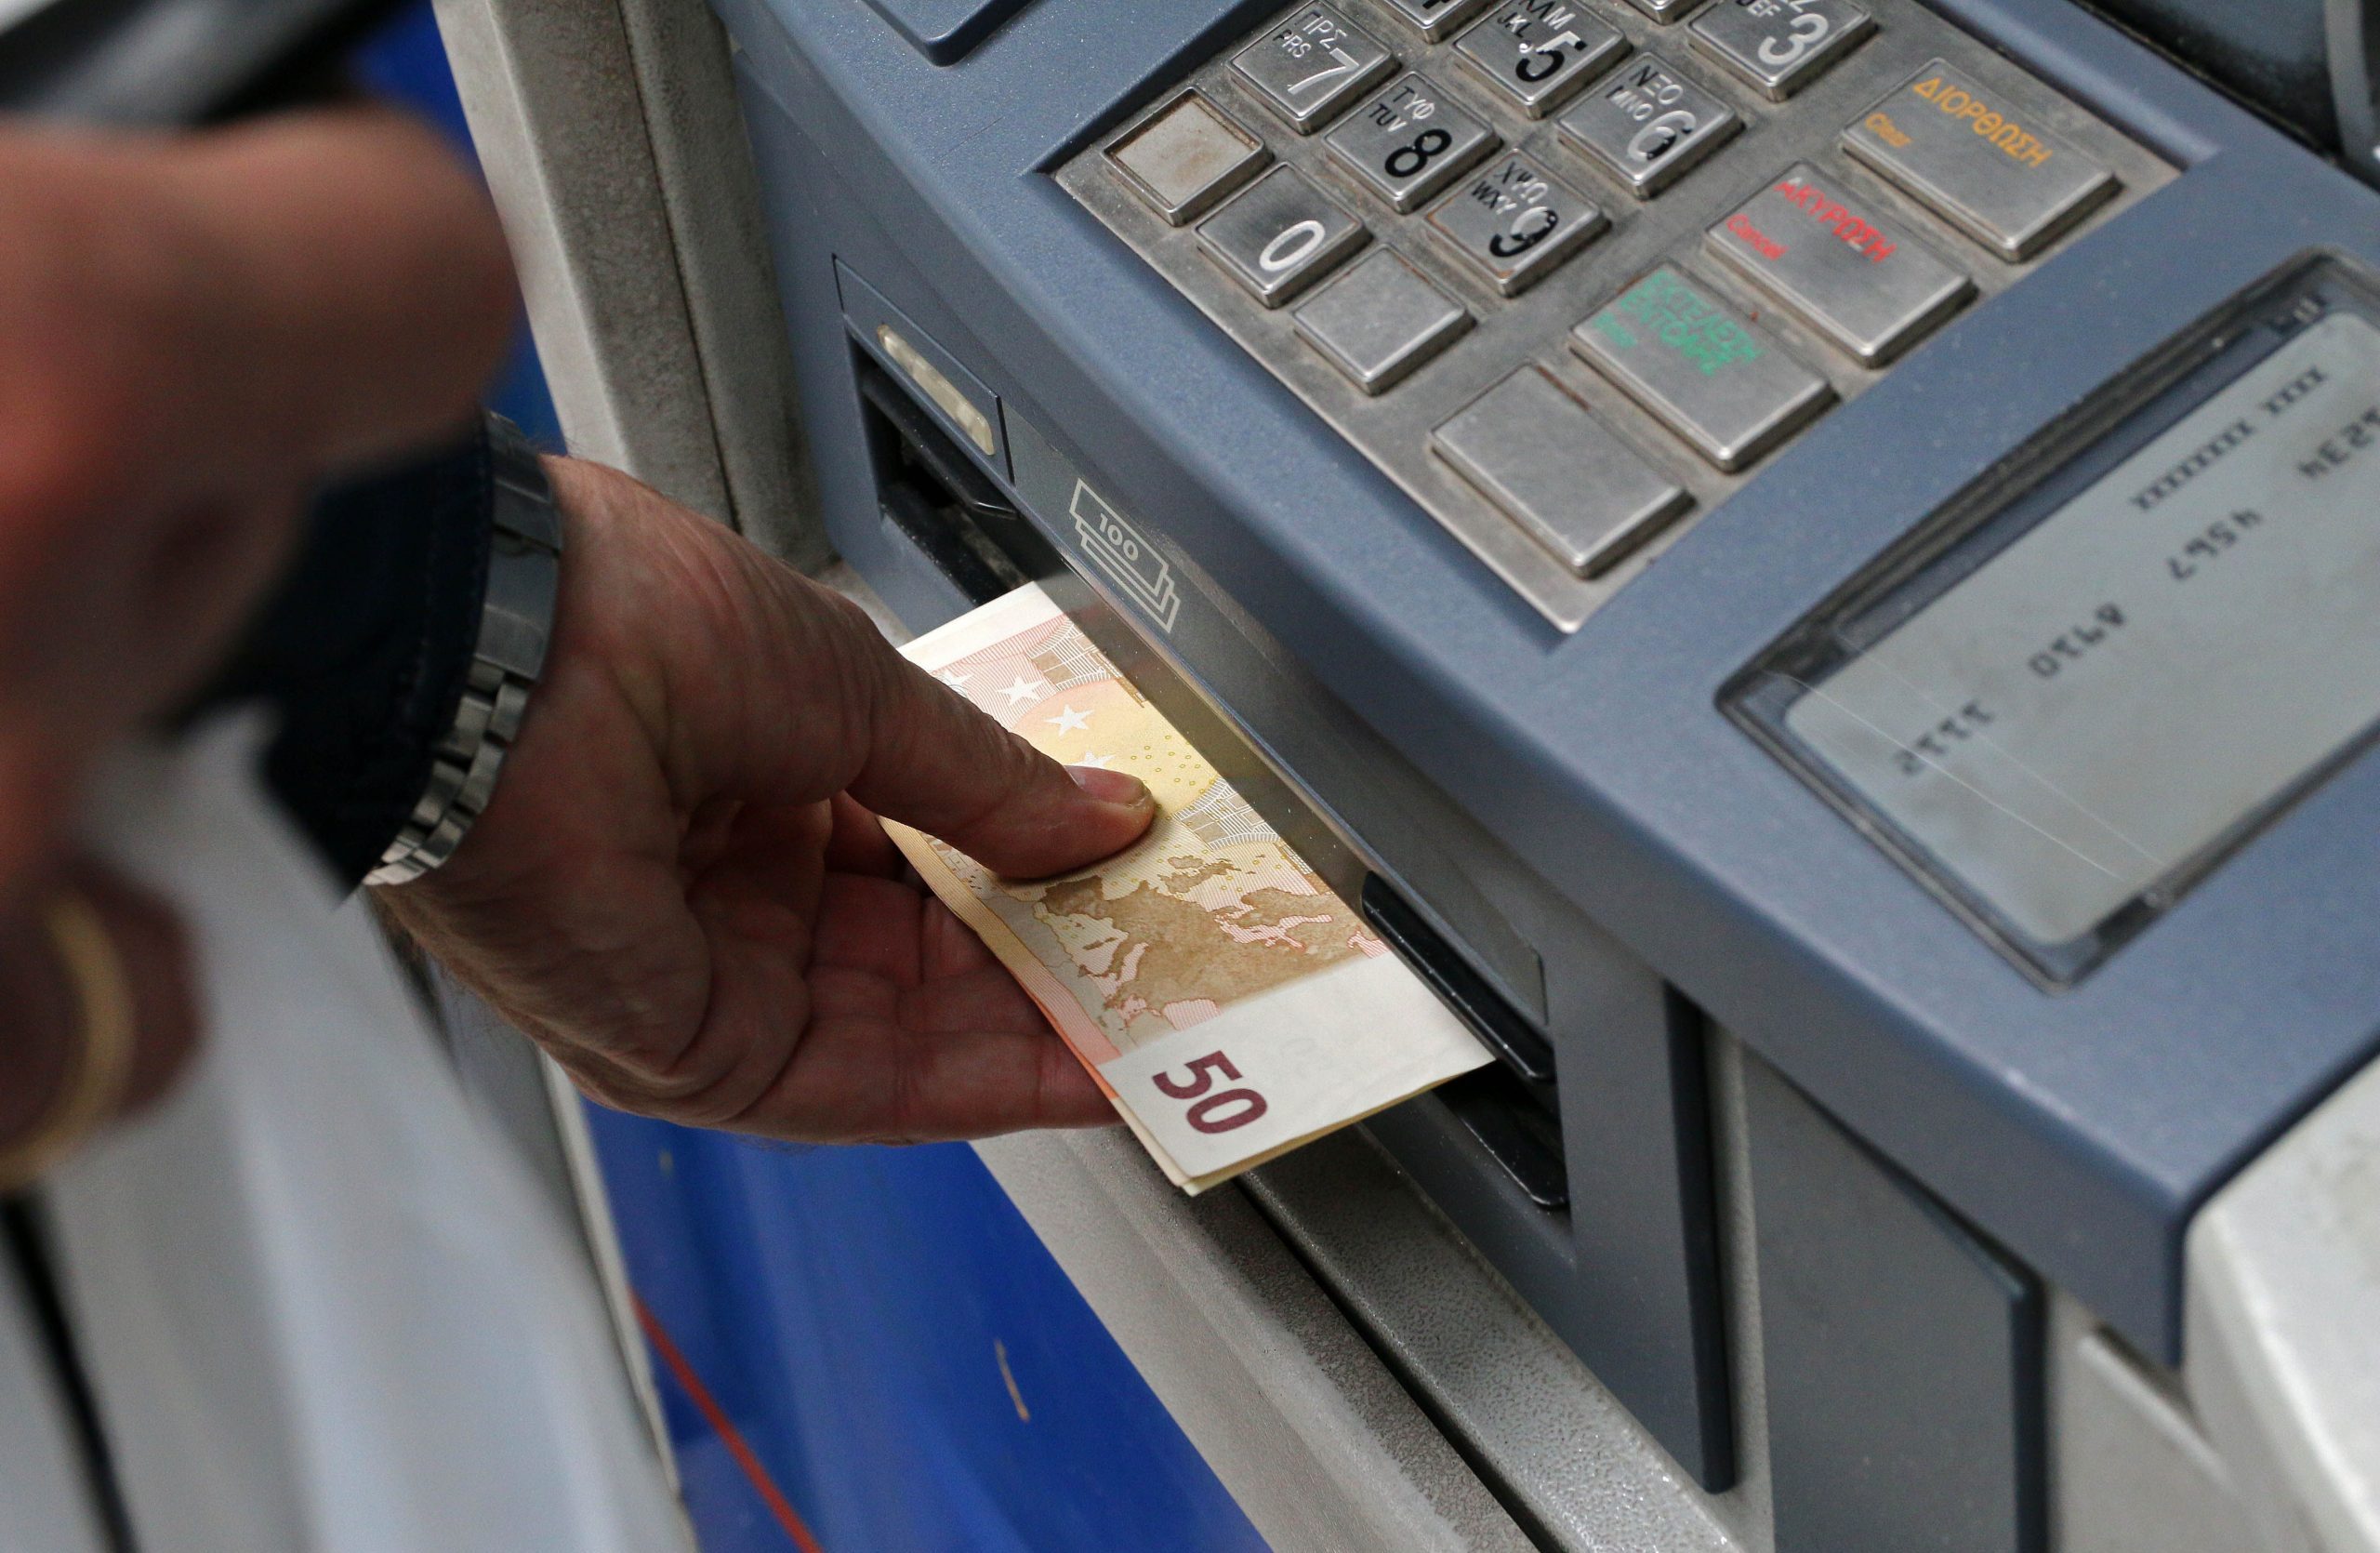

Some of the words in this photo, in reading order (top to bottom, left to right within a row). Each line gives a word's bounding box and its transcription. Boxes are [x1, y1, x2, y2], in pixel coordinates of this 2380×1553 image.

[1273, 29, 1312, 59] PRS
[1497, 12, 1532, 38] JKL
[1758, 13, 1829, 65] 3
[1288, 47, 1359, 95] 7
[1515, 31, 1587, 83] 5
[1369, 103, 1408, 132] TUV
[1606, 85, 1654, 121] MNO
[1913, 77, 2053, 167] ΔΙΟΡΘΩΣΗ
[1385, 128, 1452, 178] 8
[1628, 110, 1697, 163] 6
[1472, 180, 1517, 215] WXY
[1774, 178, 1897, 262] ΑΚΥΡΩΣΗ
[1260, 219, 1326, 272] 0
[1489, 206, 1558, 257] 9
[1099, 512, 1139, 562] 100
[2168, 511, 2262, 581] 4567
[2029, 604, 2125, 678] 8910
[1152, 1050, 1268, 1135] 50
